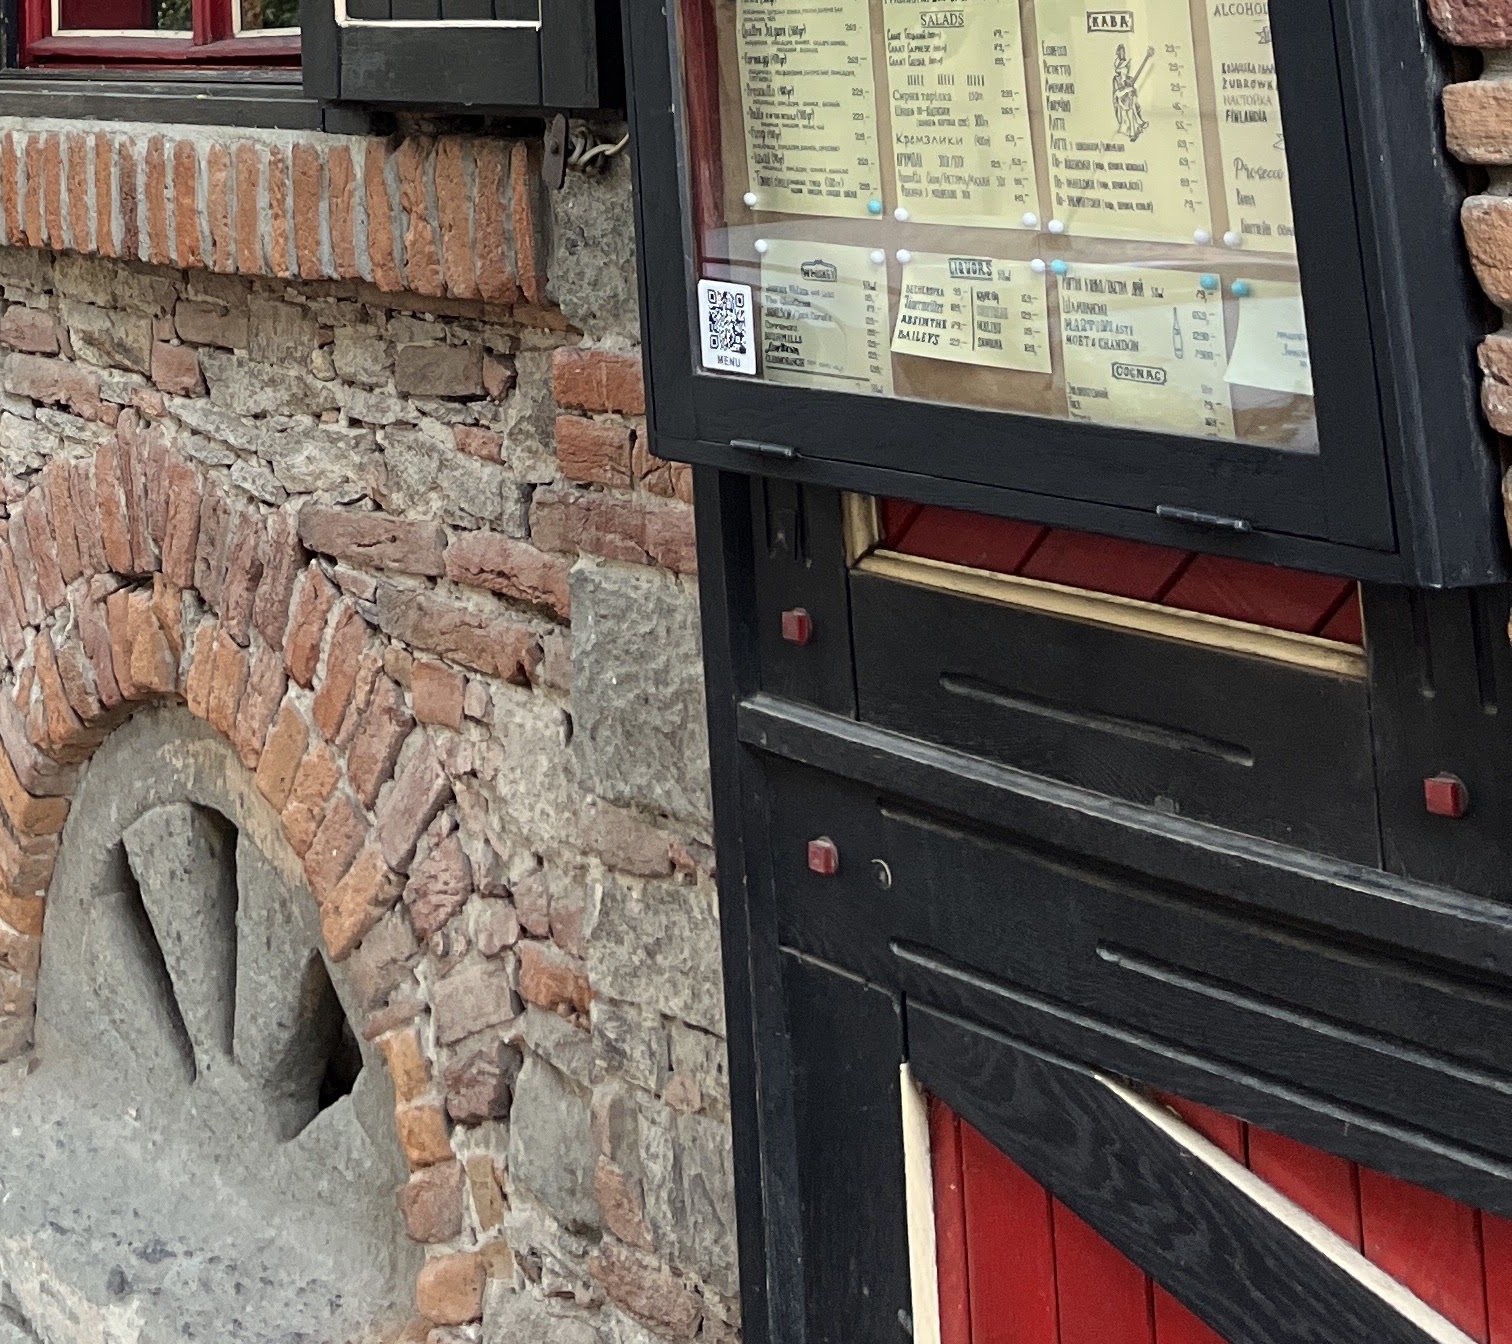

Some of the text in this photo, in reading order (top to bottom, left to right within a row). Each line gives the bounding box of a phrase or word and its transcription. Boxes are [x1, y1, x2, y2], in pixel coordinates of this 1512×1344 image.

[920, 13, 965, 26] SALADS
[1092, 16, 1129, 28] КАВА
[949, 260, 993, 277] LIQUORS
[901, 314, 948, 329] ABSINTHE
[897, 329, 940, 346] BAILEYS
[717, 355, 741, 367] MENU
[1115, 365, 1162, 381] COGNAC
